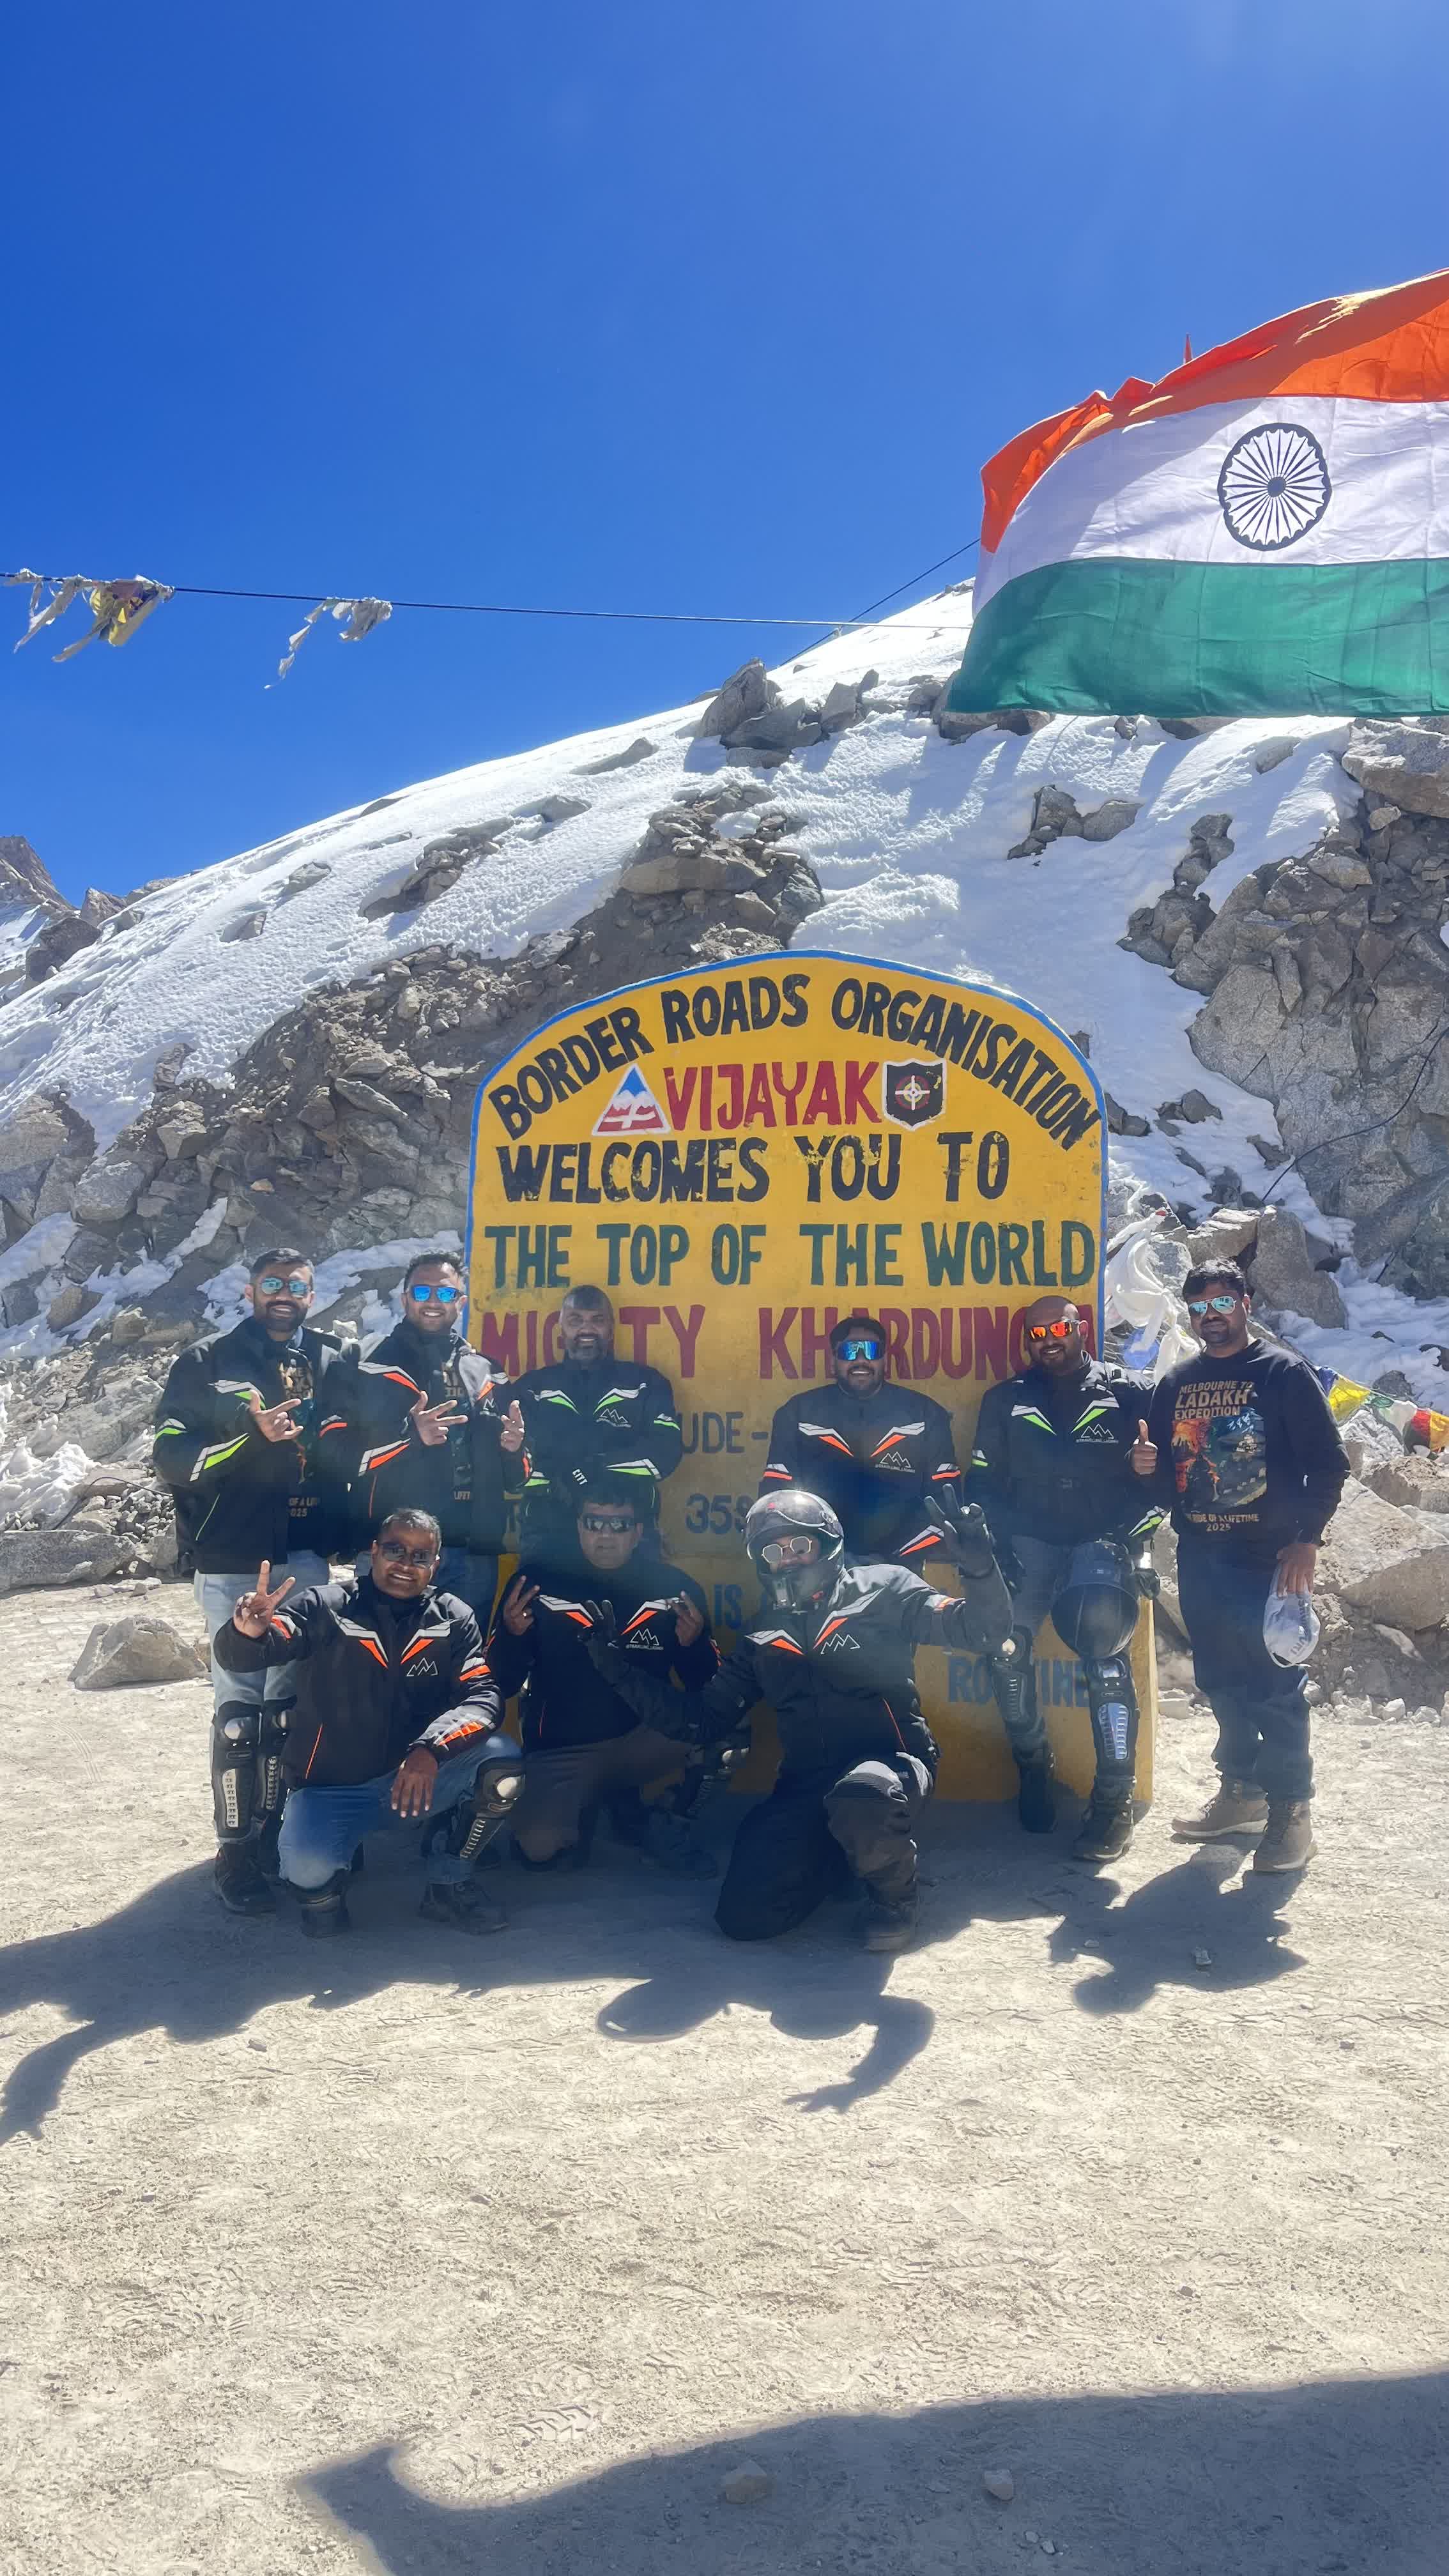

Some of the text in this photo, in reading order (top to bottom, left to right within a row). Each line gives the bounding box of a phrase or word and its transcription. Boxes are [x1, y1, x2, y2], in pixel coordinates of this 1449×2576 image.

[489, 973, 1101, 1151] BORDER ROADS ORGANISATION
[662, 1061, 882, 1131] VIJAYAK
[496, 1131, 1009, 1203] WELCOMES YOU TO
[484, 1220, 1095, 1289] THE TOP OF THE WORLD
[480, 1304, 705, 1377] MIGTY
[1179, 1380, 1254, 1394] MELBOURNE TO
[1176, 1390, 1249, 1409] LADAKH
[1174, 1406, 1241, 1420] EXPEDITION
[572, 1469, 588, 1485] CITY
[291, 1508, 307, 1517] 025
[1206, 1523, 1232, 1532] 2025
